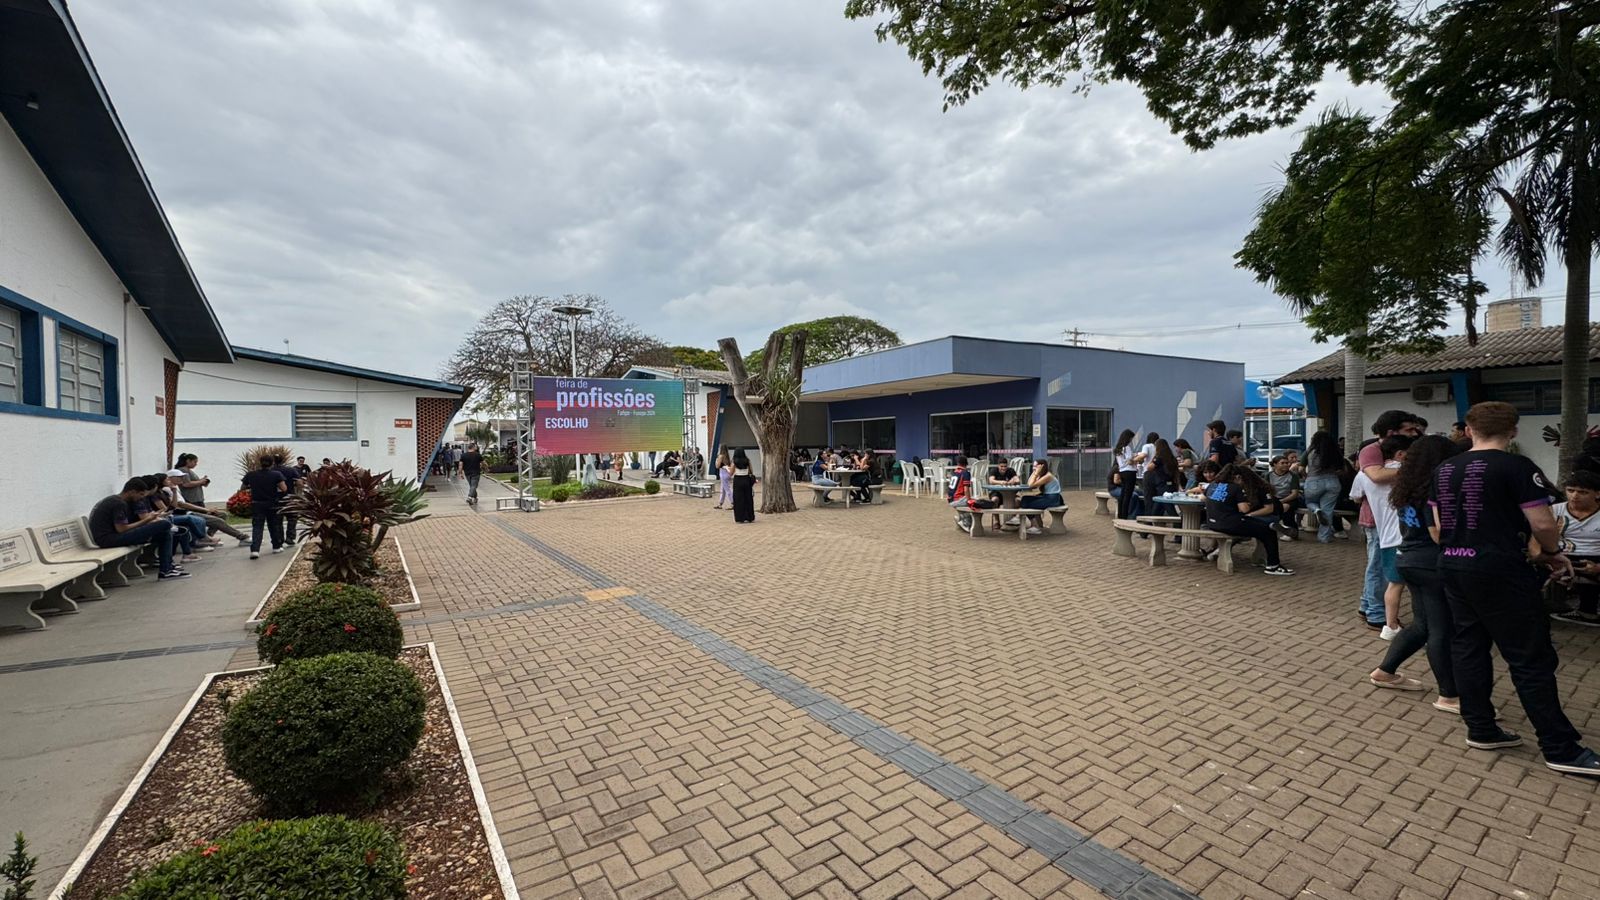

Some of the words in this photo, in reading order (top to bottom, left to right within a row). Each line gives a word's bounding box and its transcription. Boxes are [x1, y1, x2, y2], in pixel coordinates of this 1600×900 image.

[556, 378, 575, 388] feira
[577, 379, 588, 388] de
[556, 387, 655, 411] profissões
[545, 417, 588, 429] ESCOLHO
